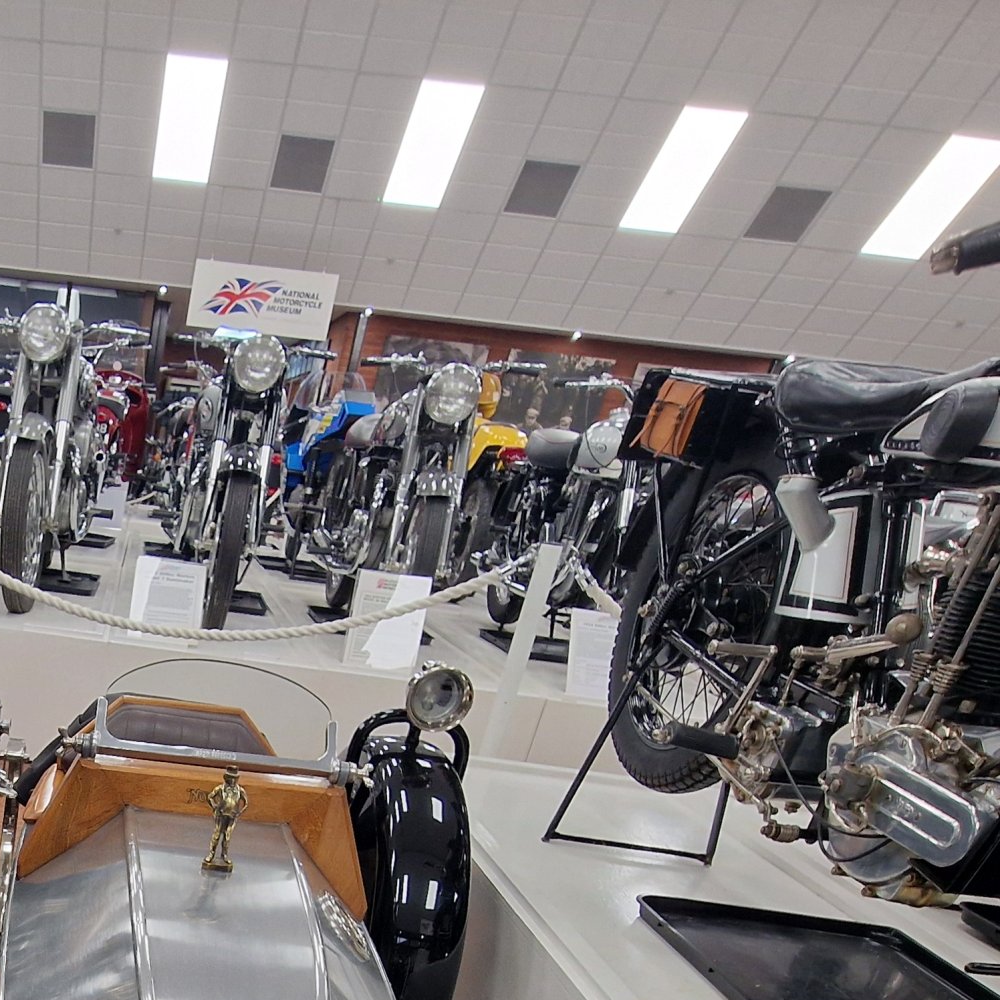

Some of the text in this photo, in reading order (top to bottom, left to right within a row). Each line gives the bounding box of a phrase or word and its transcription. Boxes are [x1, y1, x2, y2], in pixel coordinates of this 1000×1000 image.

[282, 290, 320, 300] NATIONAL
[274, 297, 323, 309] MOTORCYCLE
[266, 305, 302, 315] MUSEUM
